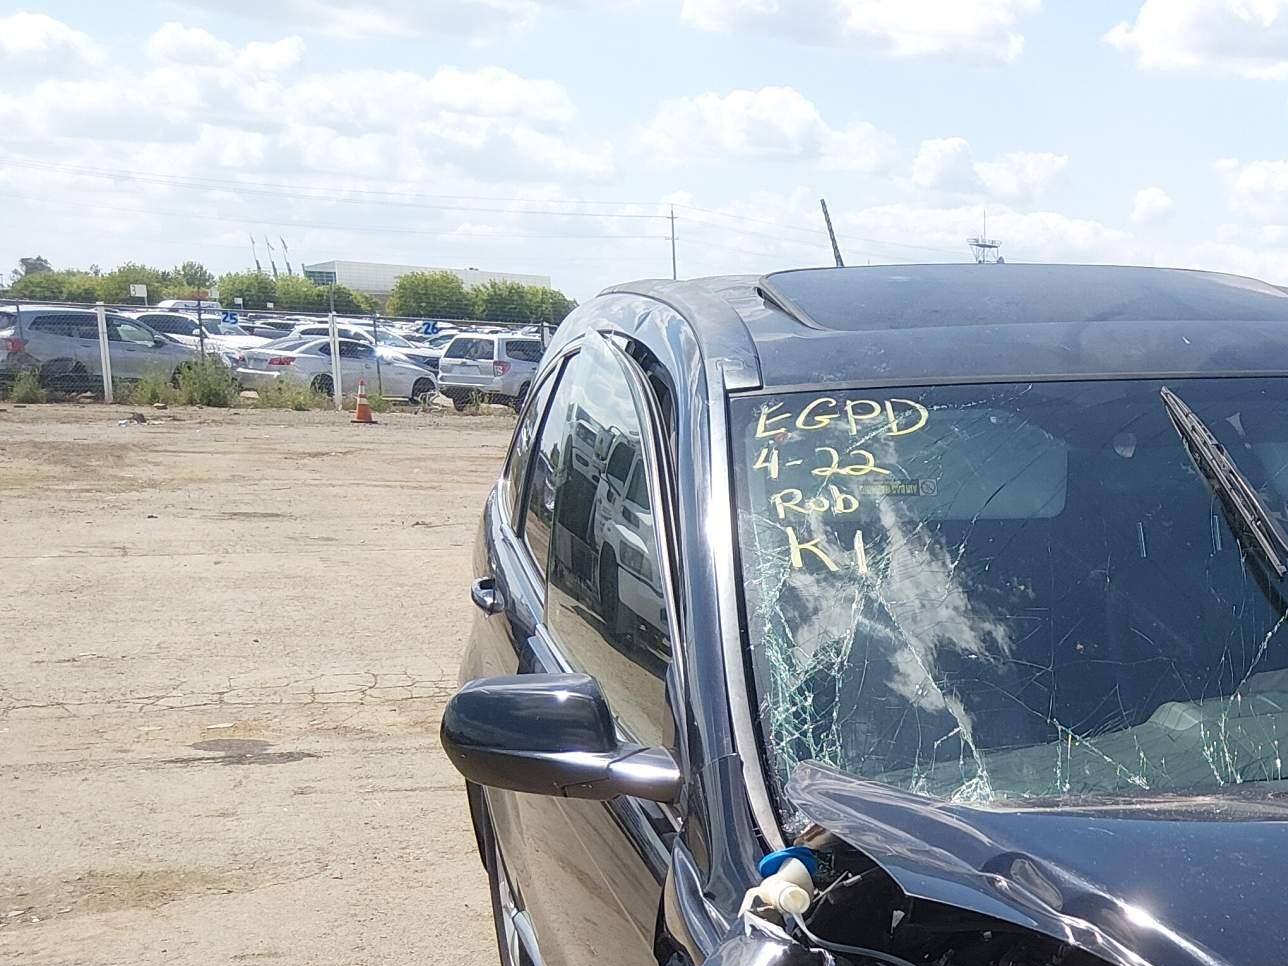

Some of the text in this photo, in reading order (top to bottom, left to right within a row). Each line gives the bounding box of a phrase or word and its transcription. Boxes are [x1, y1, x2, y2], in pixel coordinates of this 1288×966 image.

[221, 311, 239, 325] 25
[422, 319, 440, 335] 26
[755, 397, 929, 438] EGPD
[753, 447, 890, 479] 4-22
